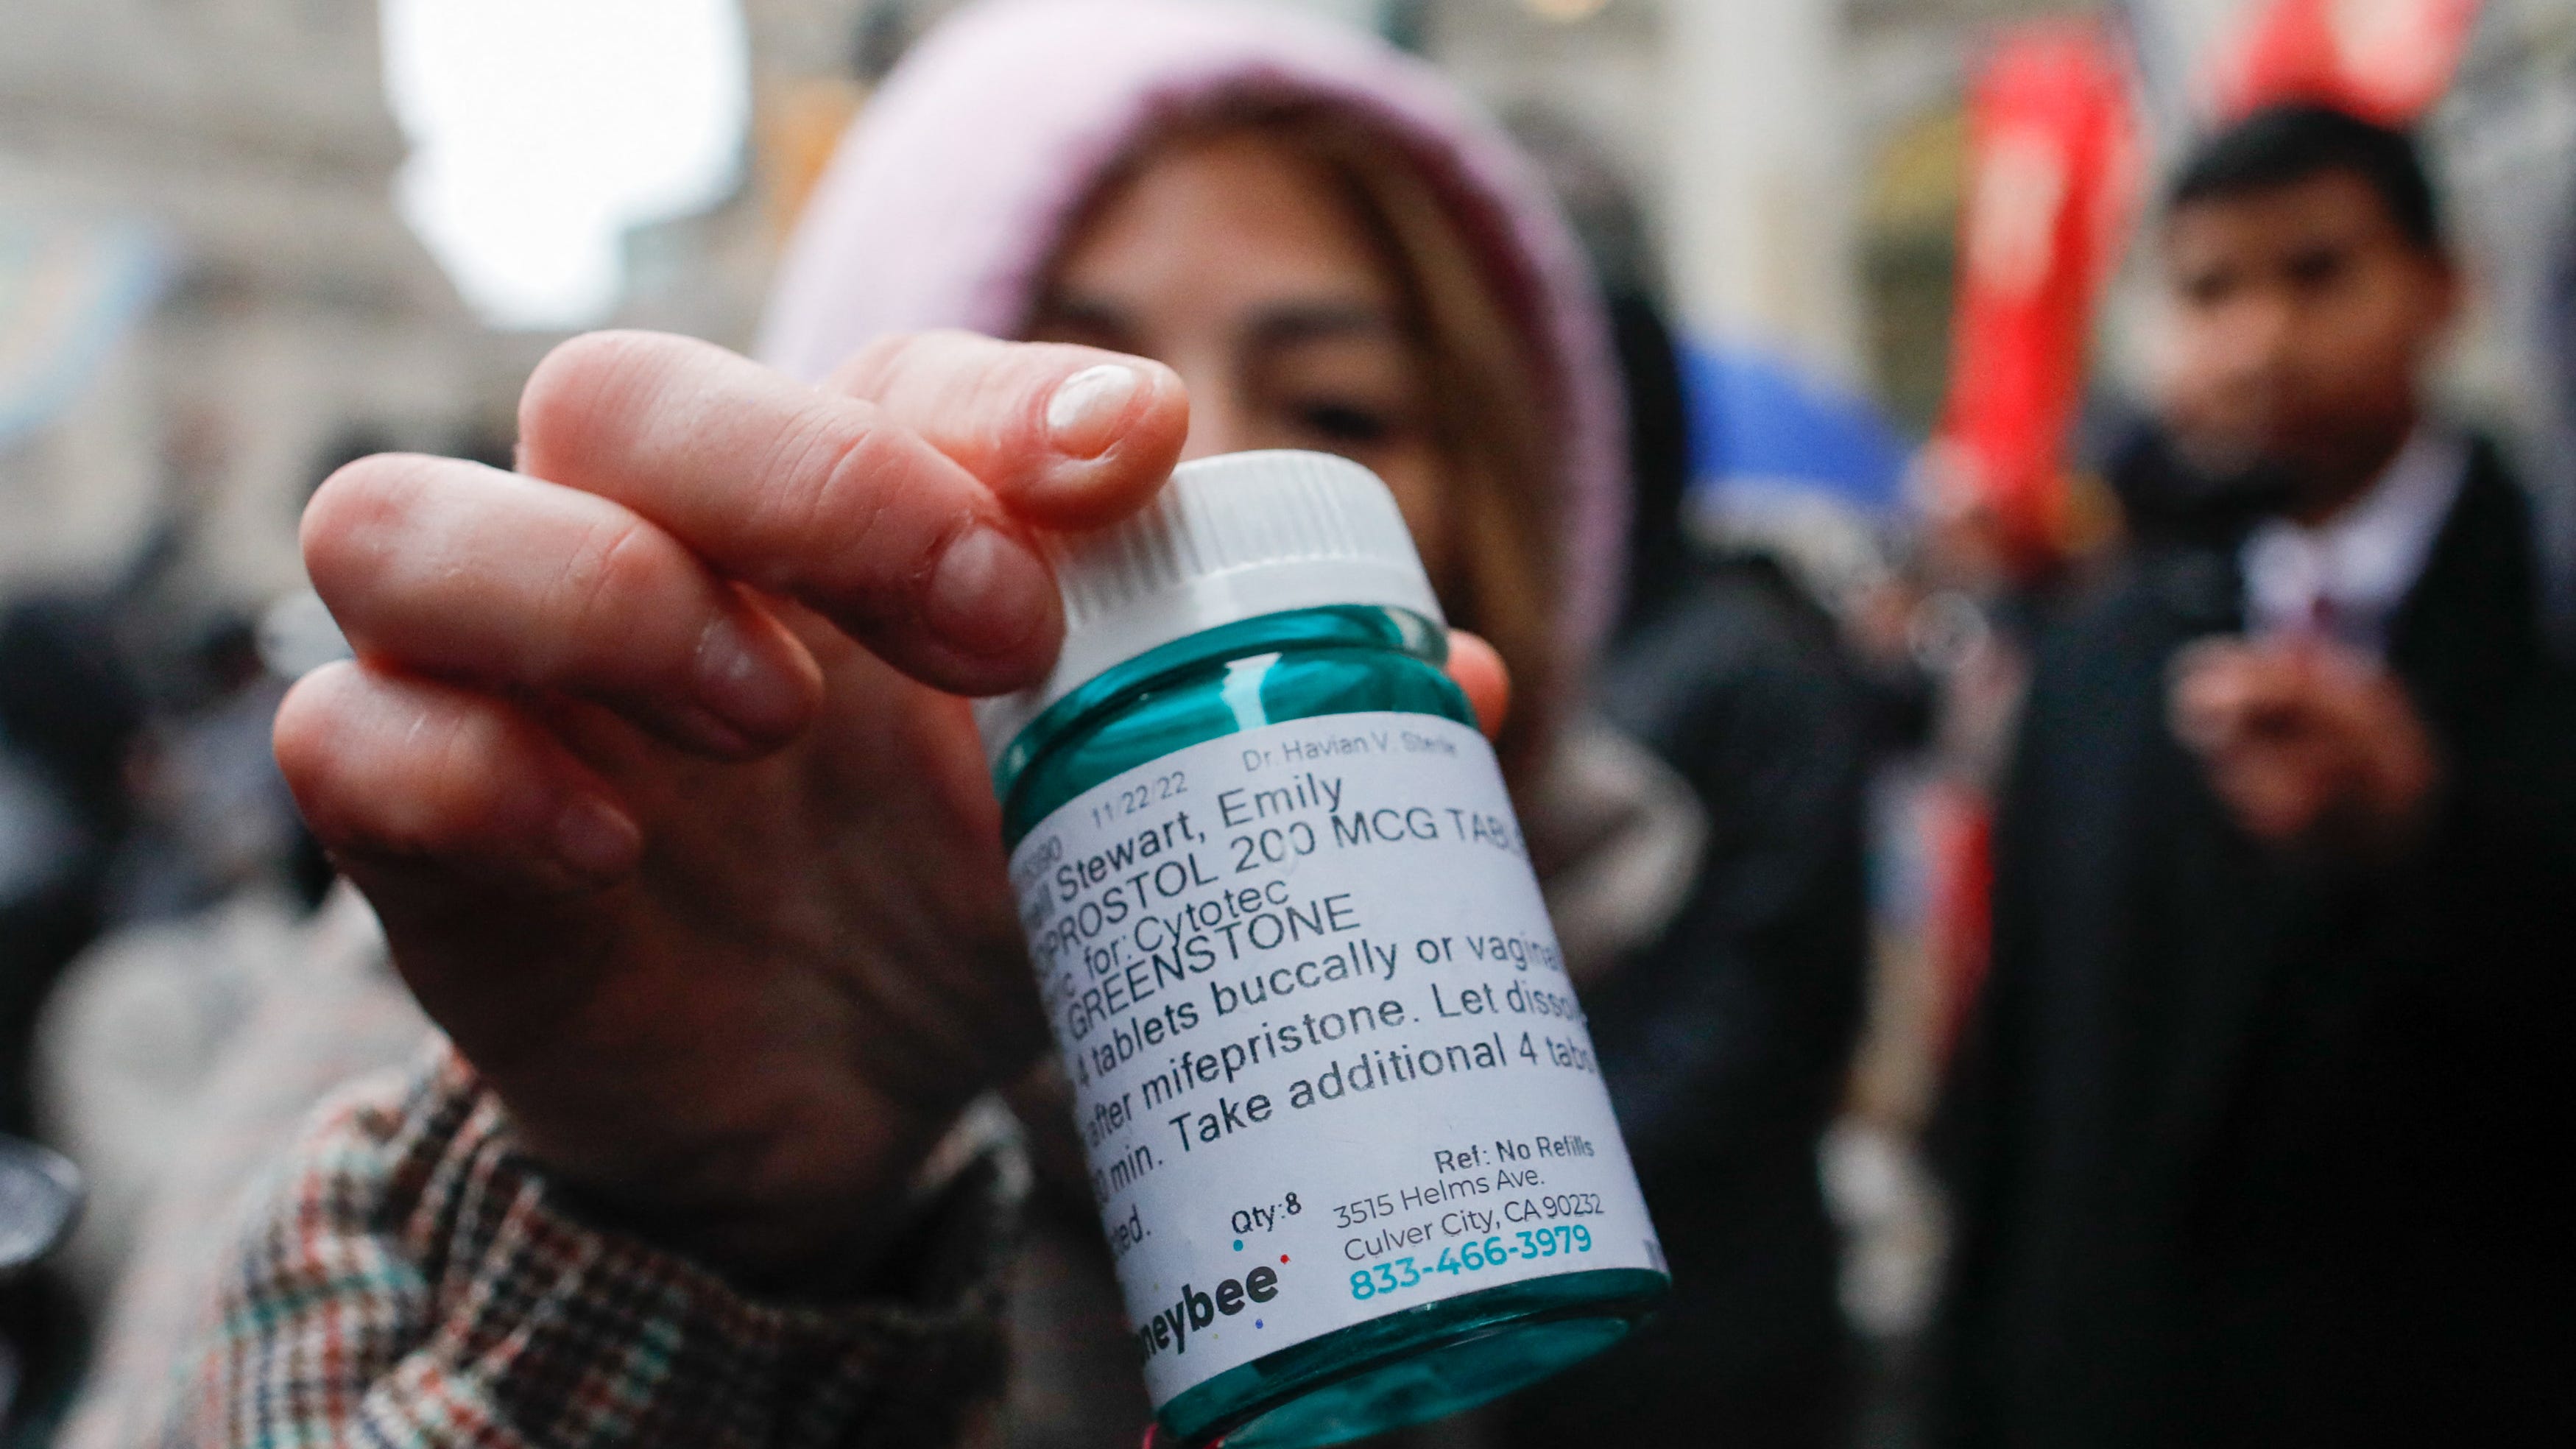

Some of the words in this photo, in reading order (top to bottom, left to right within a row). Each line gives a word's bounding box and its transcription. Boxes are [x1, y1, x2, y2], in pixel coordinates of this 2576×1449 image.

[1056, 811, 1206, 903] Stewart,
[1218, 773, 1343, 829] Emily
[1230, 821, 1316, 874] 200
[1330, 807, 1439, 848] MCG
[1445, 808, 1520, 853] TAB
[1134, 880, 1289, 953] Cytotec
[1068, 893, 1361, 1041] GREENSTONE
[1091, 999, 1199, 1077] tablets
[1210, 938, 1398, 1018] buccally
[1416, 935, 1453, 965] or
[1086, 1093, 1132, 1148] after
[1142, 999, 1420, 1110] mifepristone.
[1431, 982, 1498, 1019] Let
[1110, 1144, 1163, 1192] min.
[1168, 1093, 1274, 1153] Take
[1289, 1032, 1507, 1110] additional
[1520, 1032, 1538, 1065] 4
[1434, 1144, 1491, 1174] Ref:
[1495, 1139, 1532, 1164] No
[1536, 1135, 1595, 1160] Refills
[1232, 1191, 1302, 1235] Qty:8
[1334, 1194, 1394, 1229] 3515
[1401, 1174, 1491, 1211] Helms
[1497, 1168, 1545, 1192] Ave.
[1344, 1221, 1434, 1262] Culver
[1441, 1209, 1500, 1238] City,
[1504, 1199, 1542, 1223] CA
[1544, 1193, 1605, 1219] 90232
[1350, 1224, 1592, 1301] 833-466-3979
[1135, 1265, 1279, 1361] neybee
